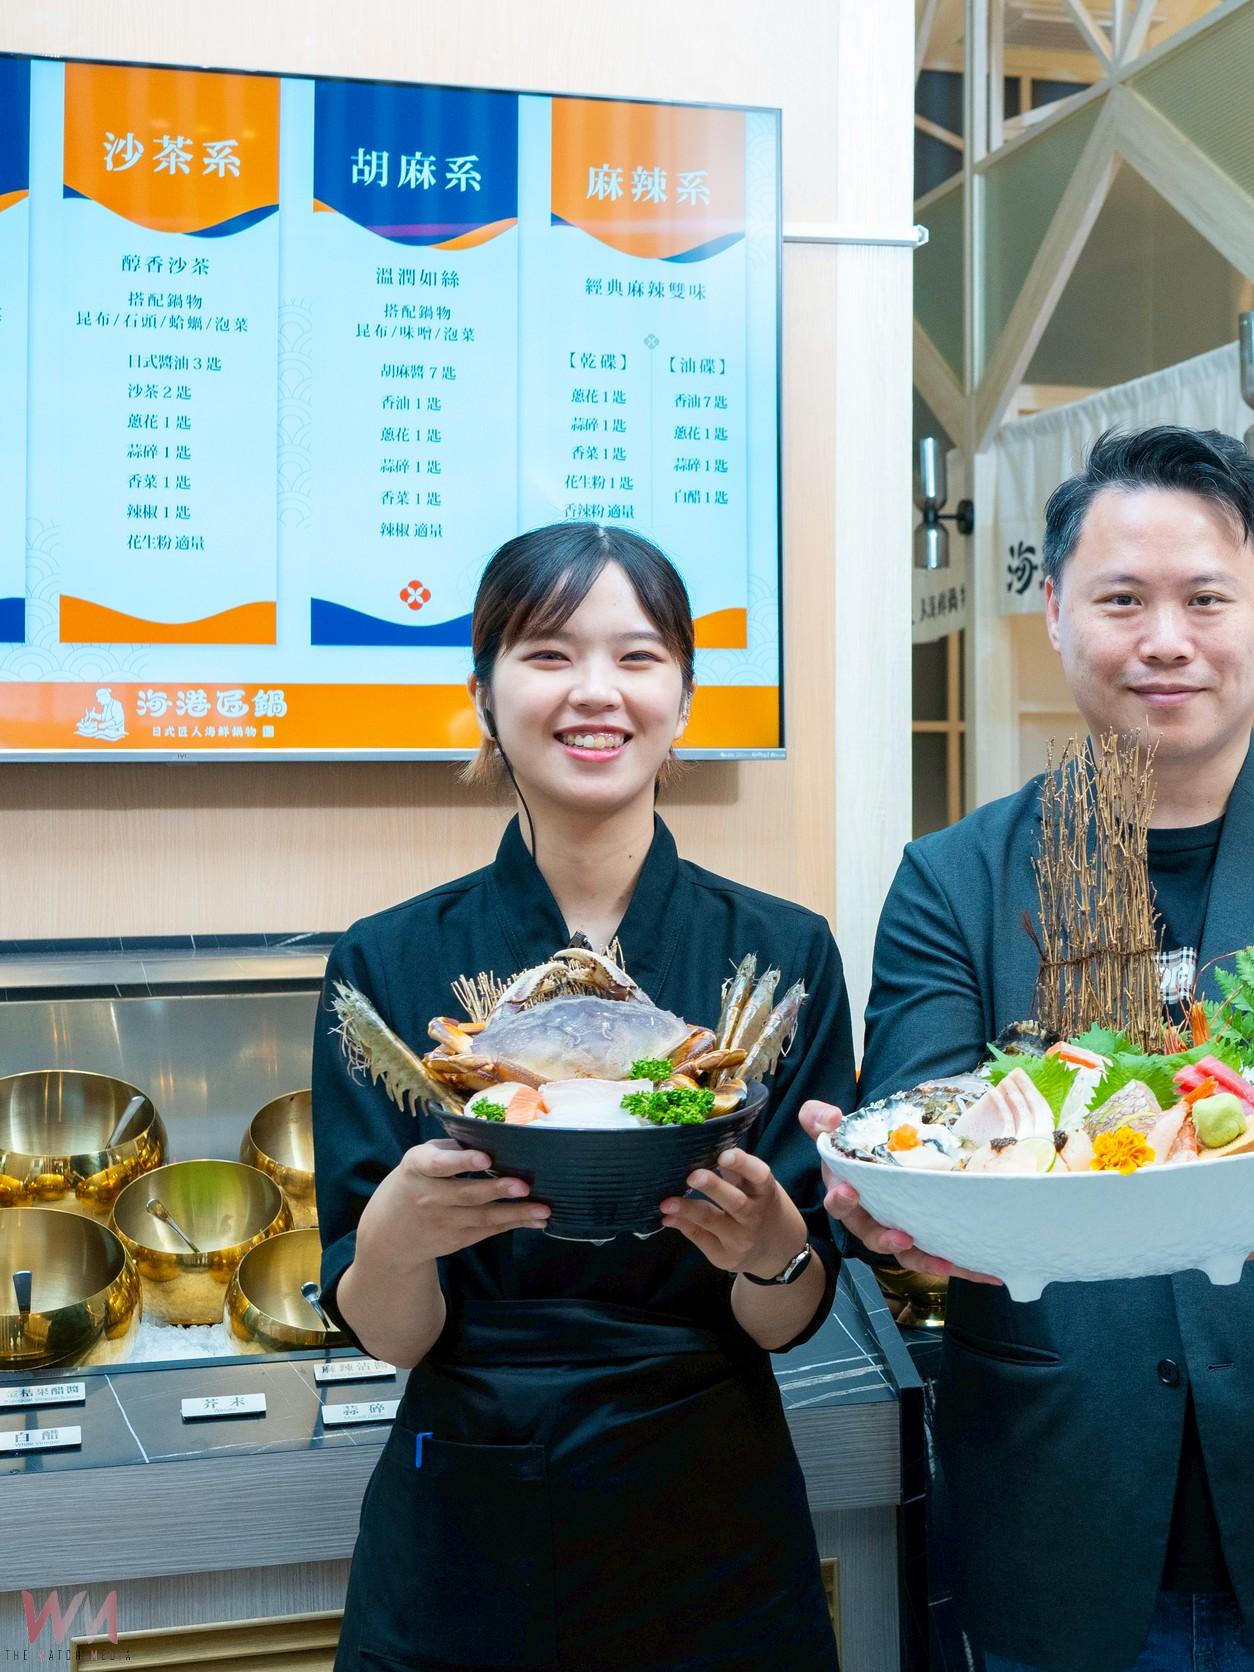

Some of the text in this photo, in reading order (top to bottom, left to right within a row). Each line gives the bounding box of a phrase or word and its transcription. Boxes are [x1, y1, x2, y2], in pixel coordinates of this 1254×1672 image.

[103, 131, 242, 179] 沙茶系
[350, 147, 483, 193] 胡麻系
[586, 162, 711, 206] 麻辣系
[121, 254, 210, 276] 醇香沙茶
[376, 267, 460, 288] 溫潤如絲
[585, 277, 706, 301] 經典麻辣雙味
[128, 291, 203, 310] 搭配鍋物
[383, 303, 451, 321] 搭配鍋物
[1007, 541, 1044, 595] 海
[15, 1429, 59, 1443] 白醋
